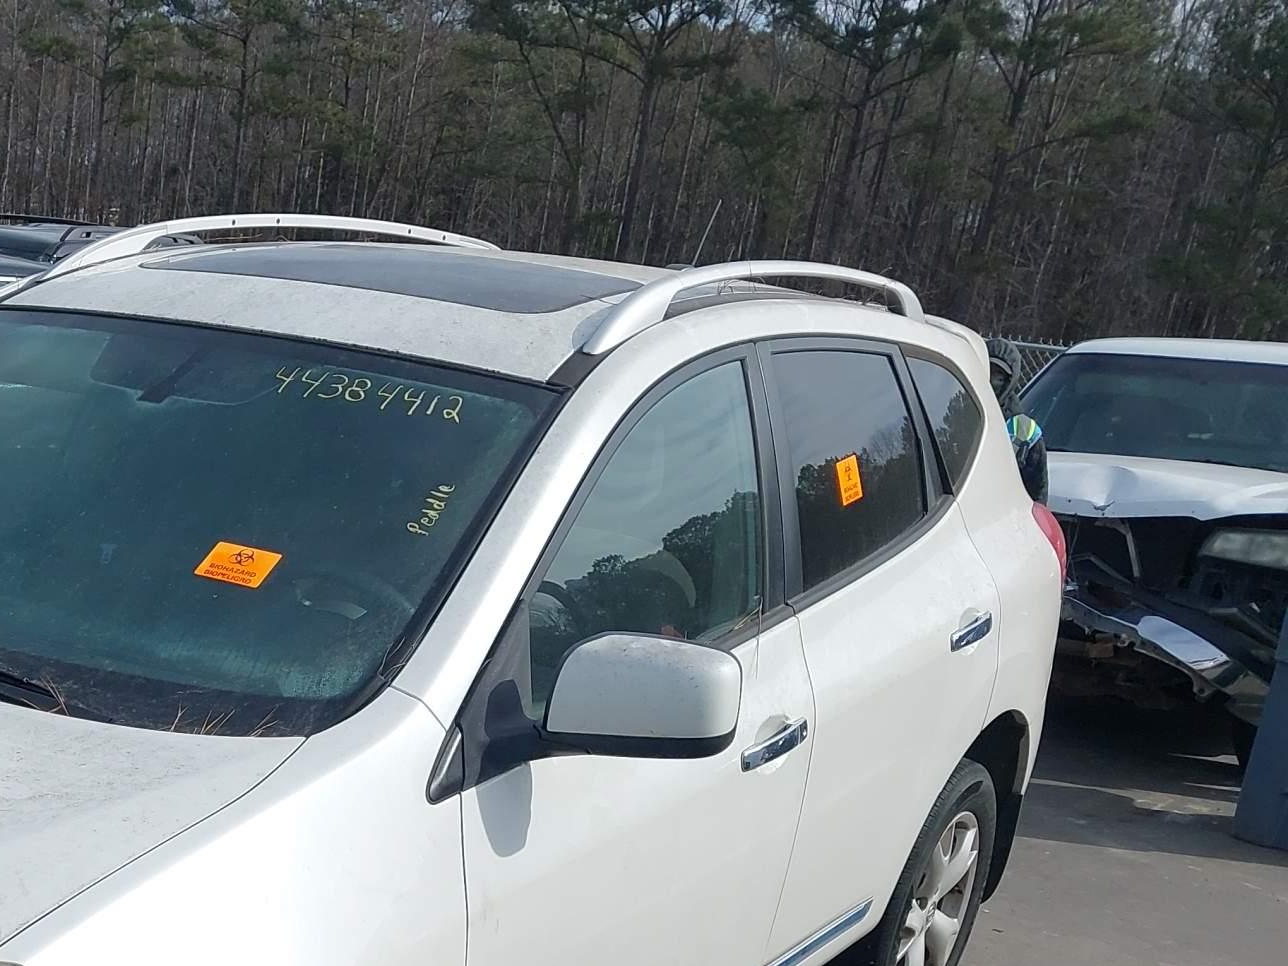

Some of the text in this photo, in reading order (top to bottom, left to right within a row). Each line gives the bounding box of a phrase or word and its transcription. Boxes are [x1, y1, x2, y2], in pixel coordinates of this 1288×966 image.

[274, 365, 464, 424] 44384412
[406, 482, 456, 537] Peddle
[203, 569, 253, 585] BIOPELIGRO
[208, 562, 257, 578] BIOHAZARD
